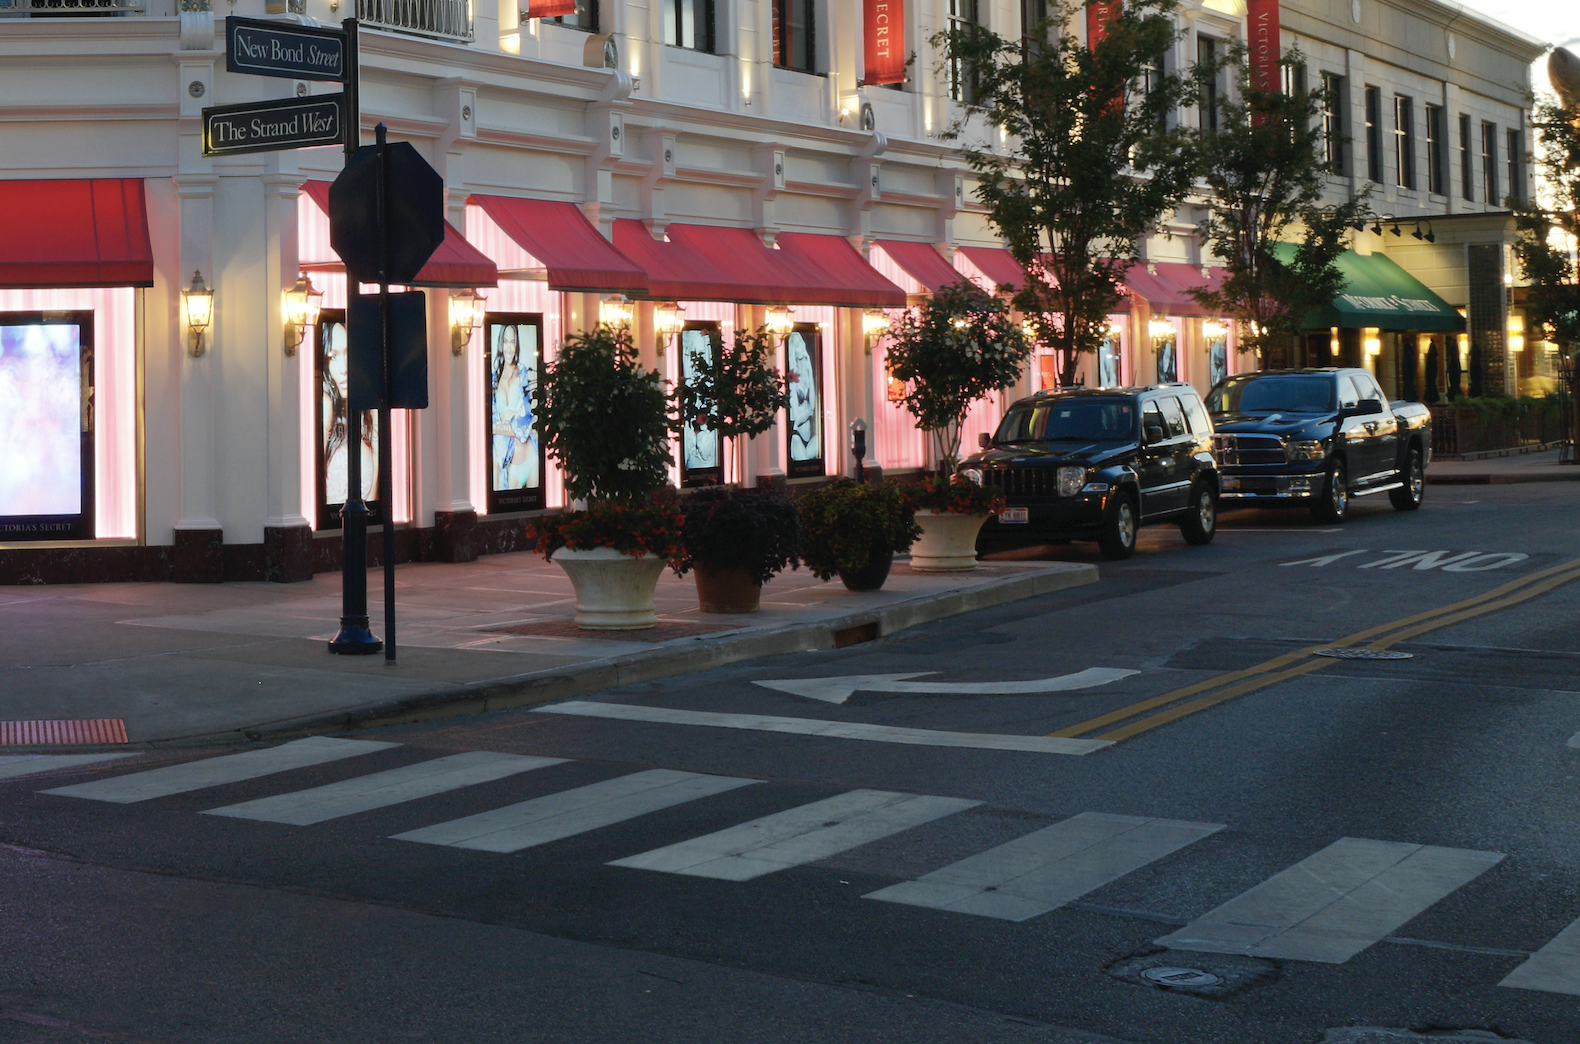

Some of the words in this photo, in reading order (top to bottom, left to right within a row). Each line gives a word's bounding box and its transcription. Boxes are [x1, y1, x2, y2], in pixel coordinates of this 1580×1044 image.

[238, 34, 269, 59] New
[271, 39, 304, 63] Bond
[307, 44, 340, 67] Street
[1258, 12, 1270, 88] VICTORIA'S
[213, 121, 247, 142] The
[251, 115, 298, 138] Strand
[302, 111, 334, 134] West
[40, 523, 72, 531] SECRET
